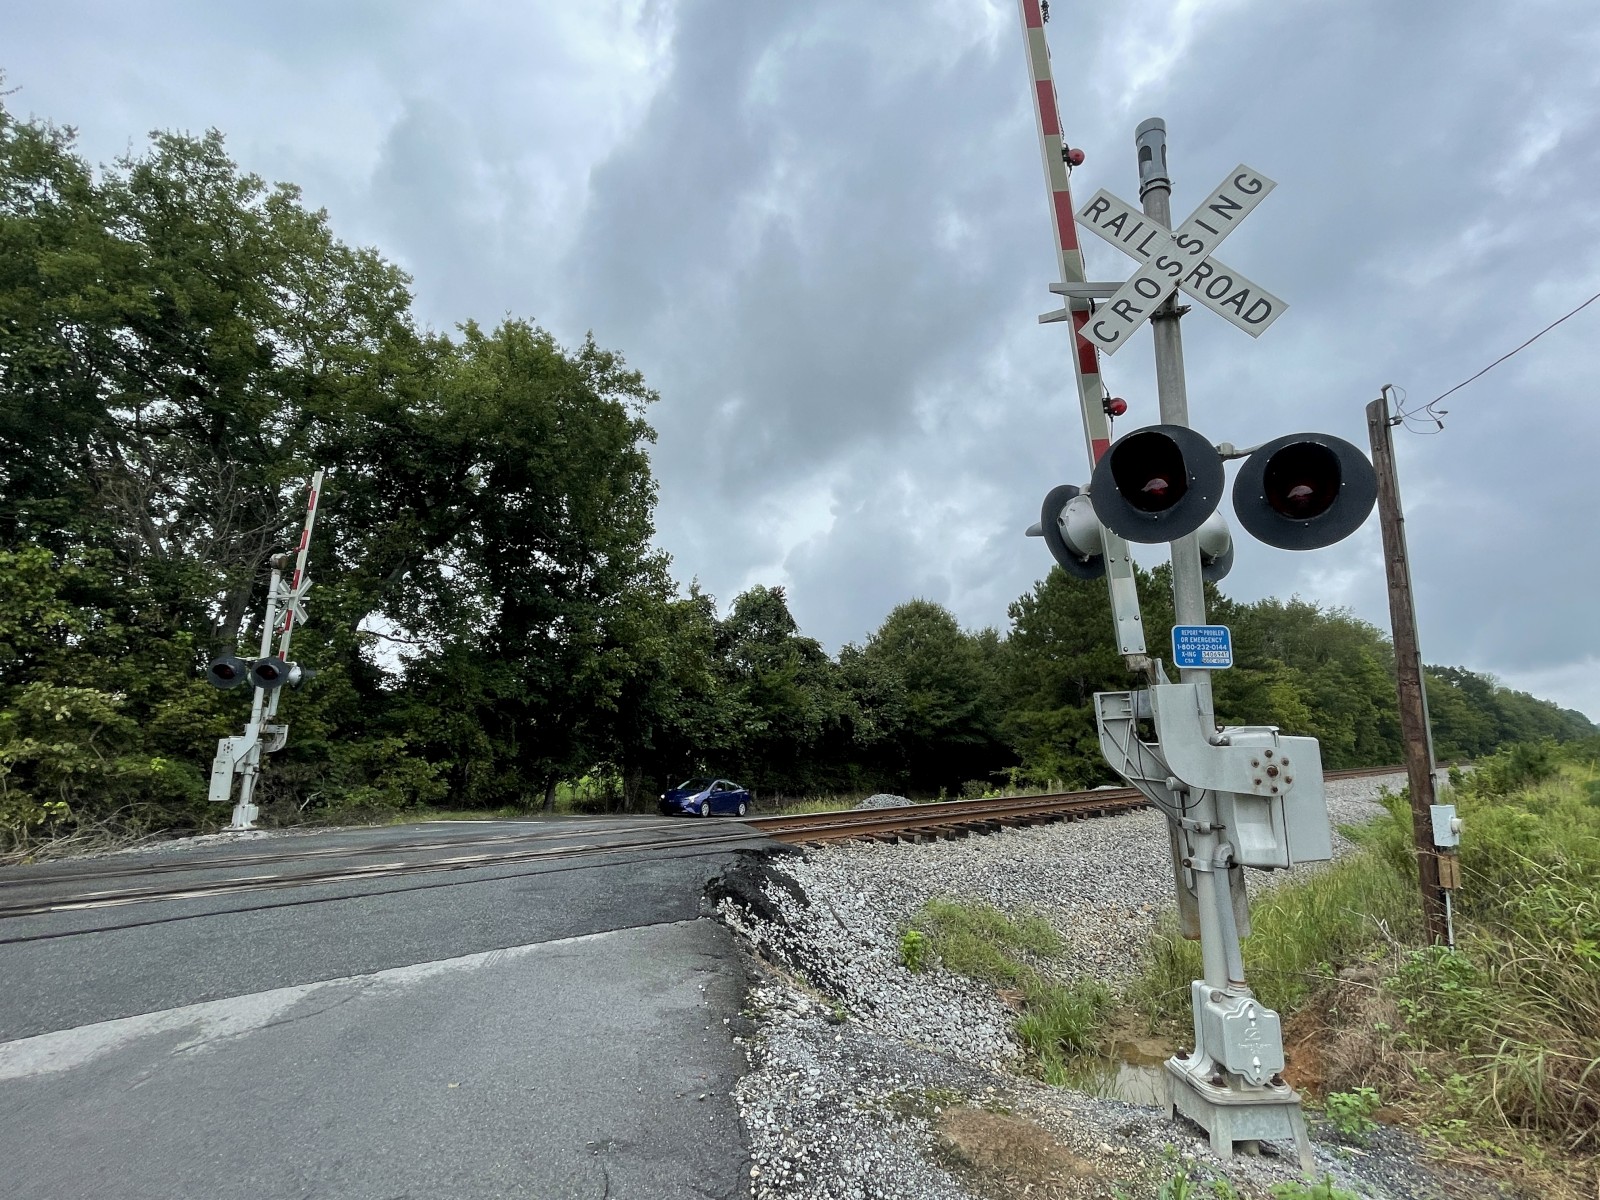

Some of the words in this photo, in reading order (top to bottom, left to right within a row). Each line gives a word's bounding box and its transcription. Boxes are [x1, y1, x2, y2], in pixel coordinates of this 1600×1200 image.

[1082, 196, 1158, 258] RAIL
[1183, 261, 1273, 325] ROAD
[1092, 173, 1263, 343] CROSSING
[1190, 636, 1222, 644] EMERGENCY
